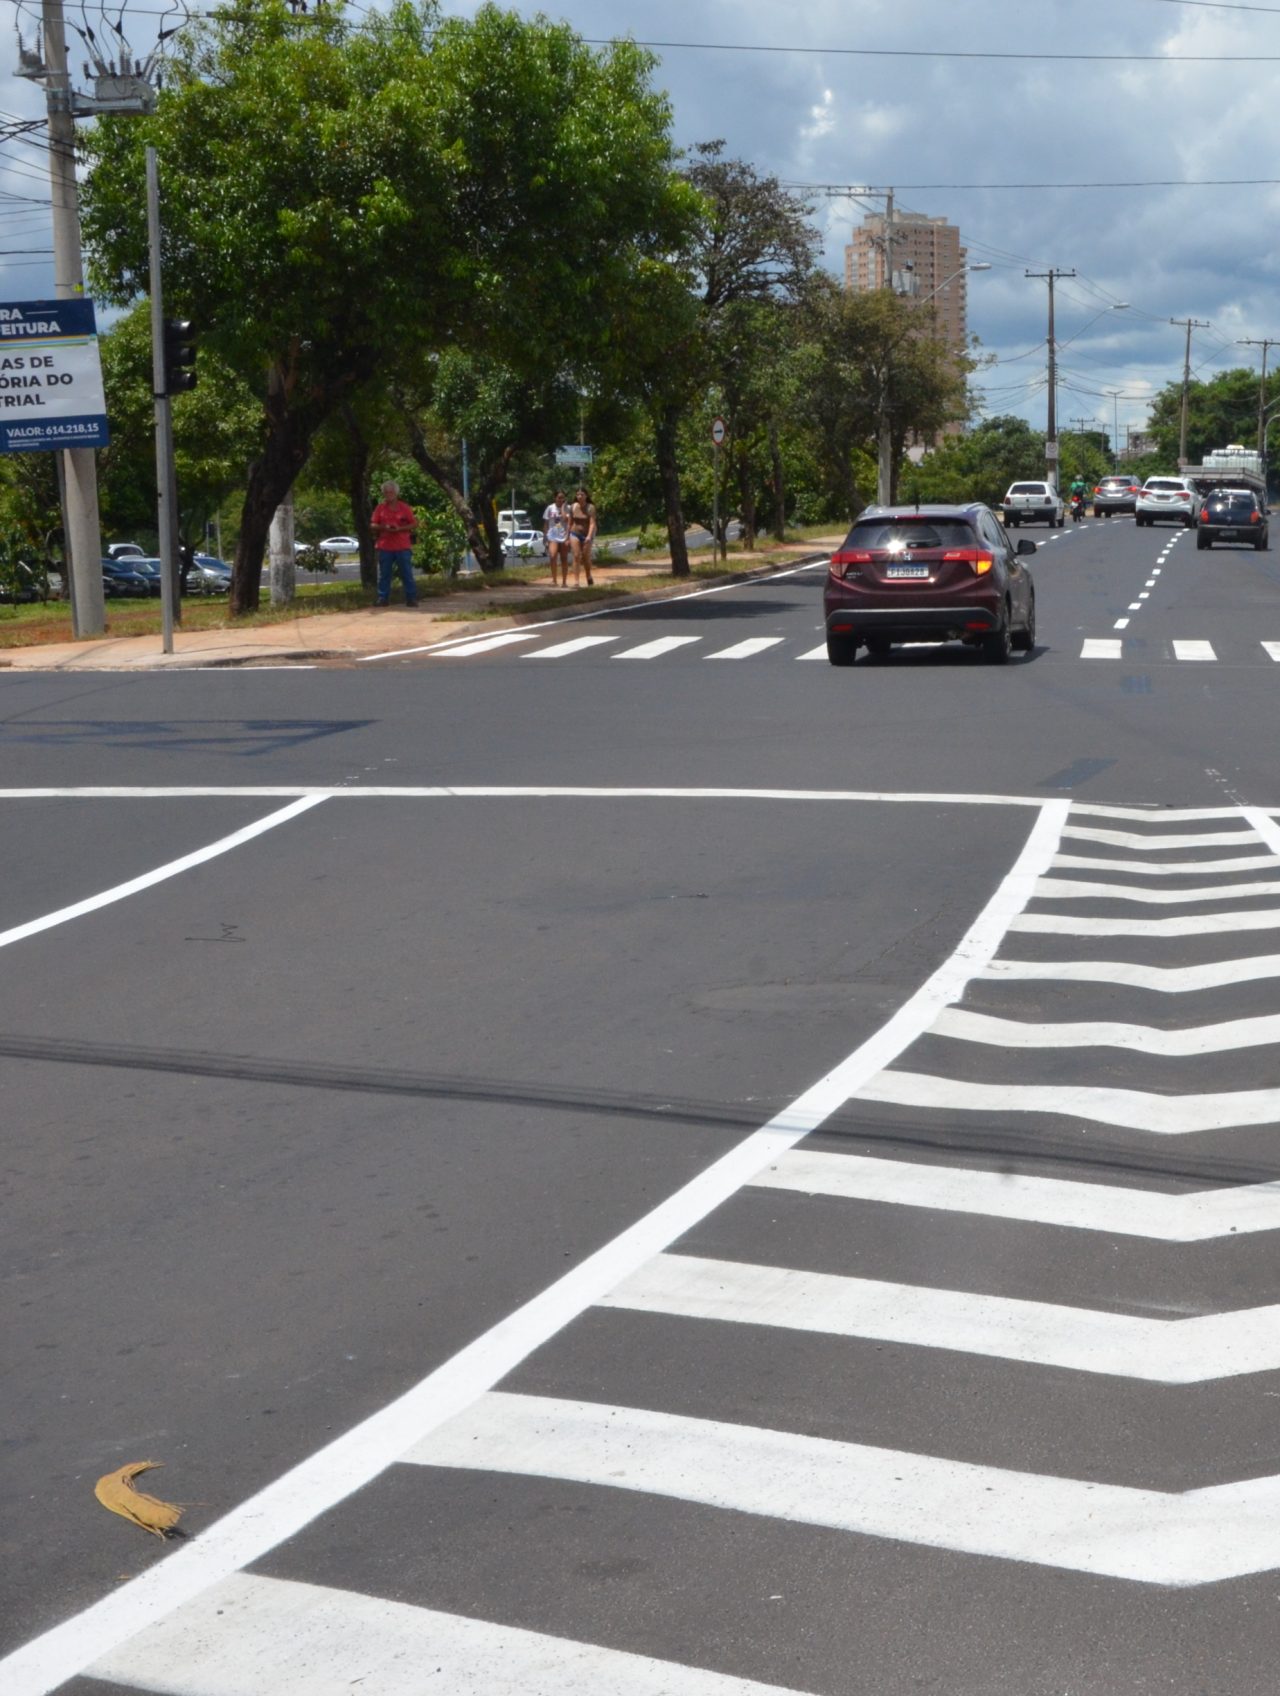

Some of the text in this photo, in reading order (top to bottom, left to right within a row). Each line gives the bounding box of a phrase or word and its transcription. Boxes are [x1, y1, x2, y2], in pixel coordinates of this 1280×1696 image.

[0, 321, 61, 336] EITURA
[30, 356, 54, 369] DE
[47, 373, 73, 386] DO
[6, 422, 100, 438] VALOR: 614.218,15
